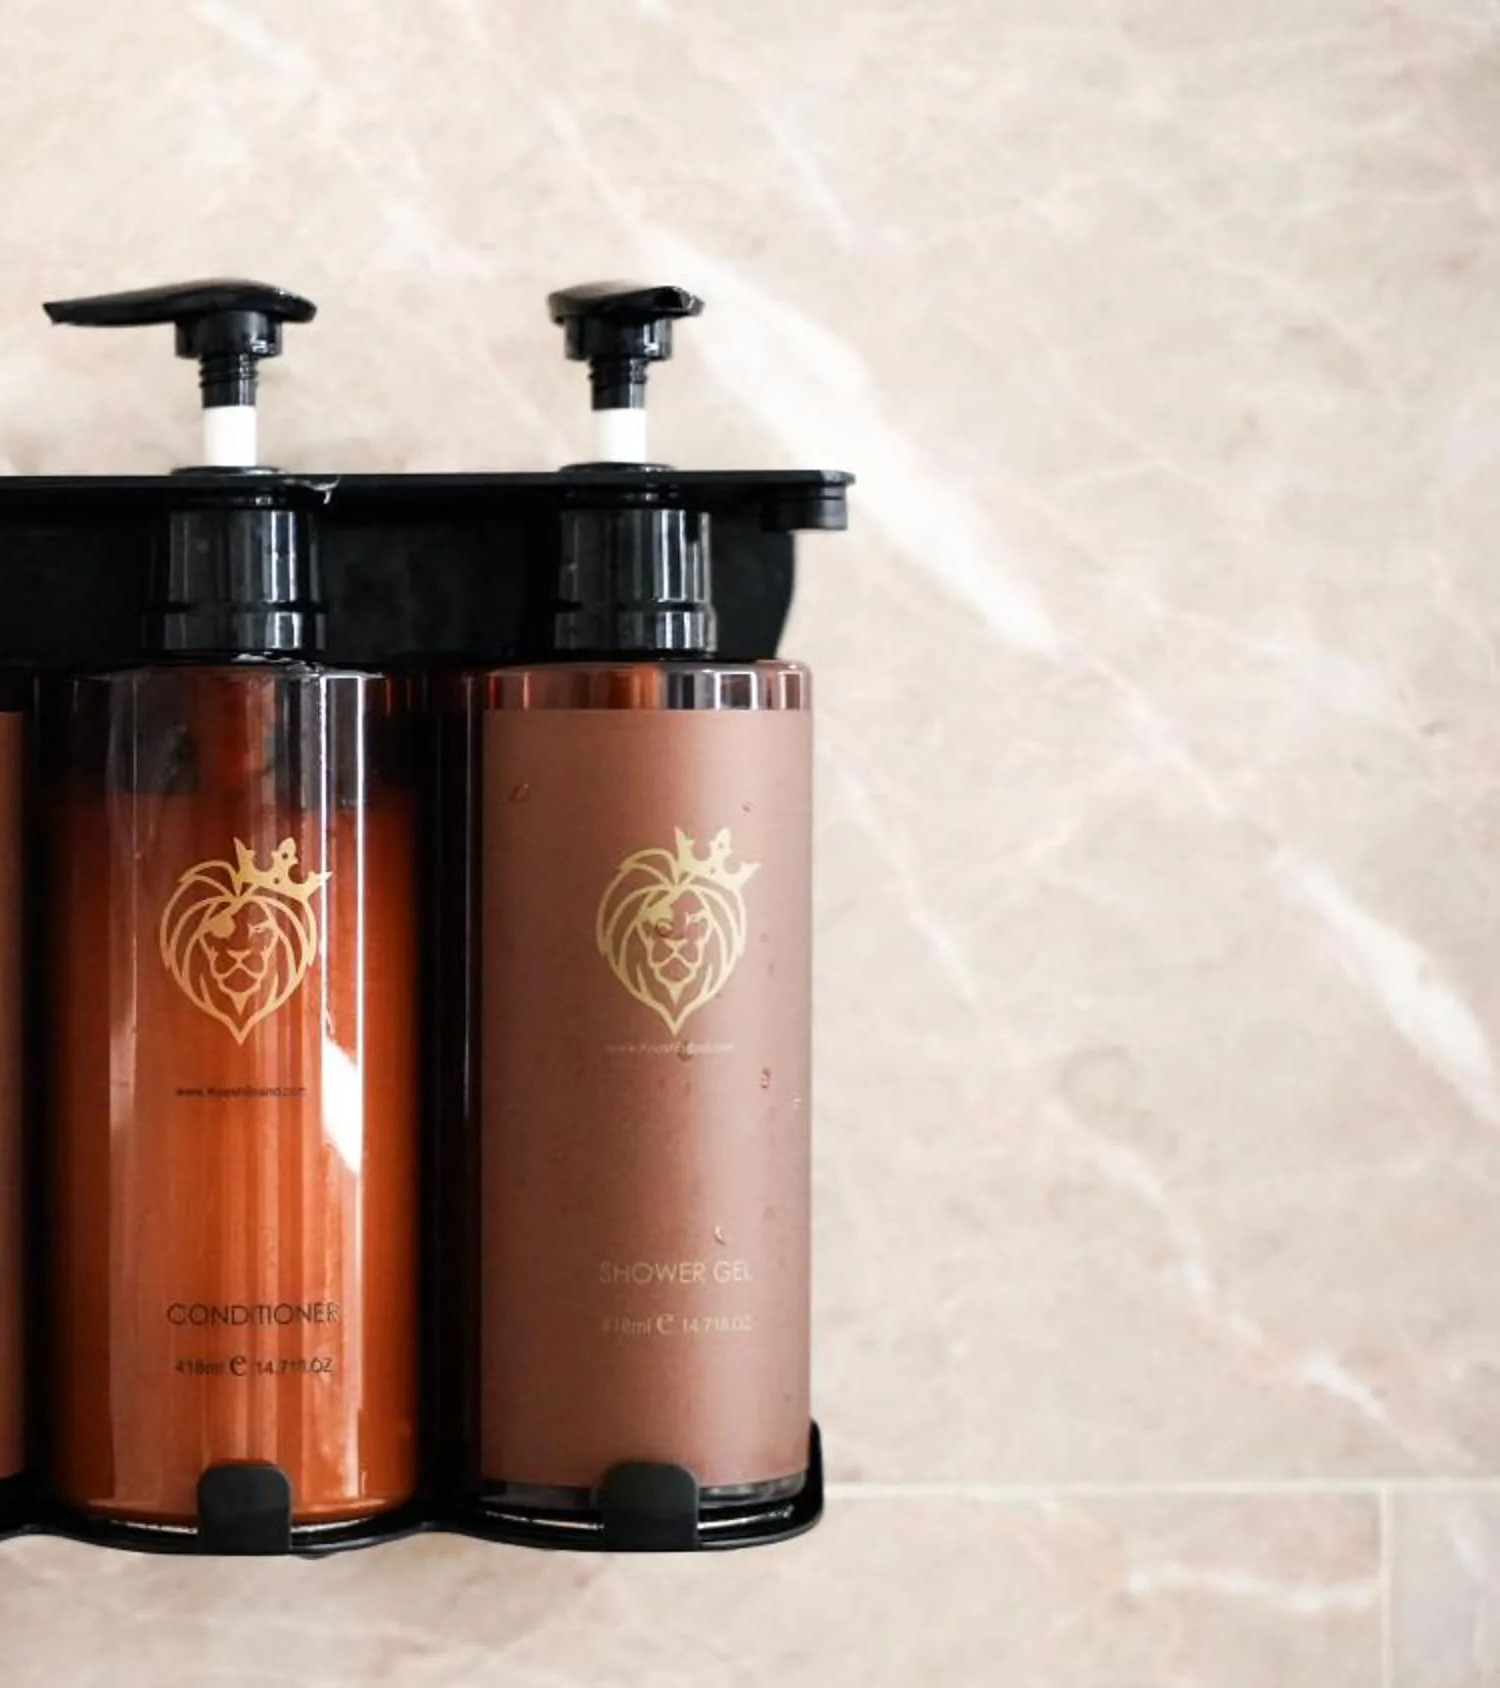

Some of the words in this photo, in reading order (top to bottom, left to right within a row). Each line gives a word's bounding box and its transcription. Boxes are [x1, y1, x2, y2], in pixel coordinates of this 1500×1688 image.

[600, 1261, 706, 1284] SHOWER
[713, 1260, 753, 1282] GEL
[166, 1302, 339, 1326] CONDITIONER
